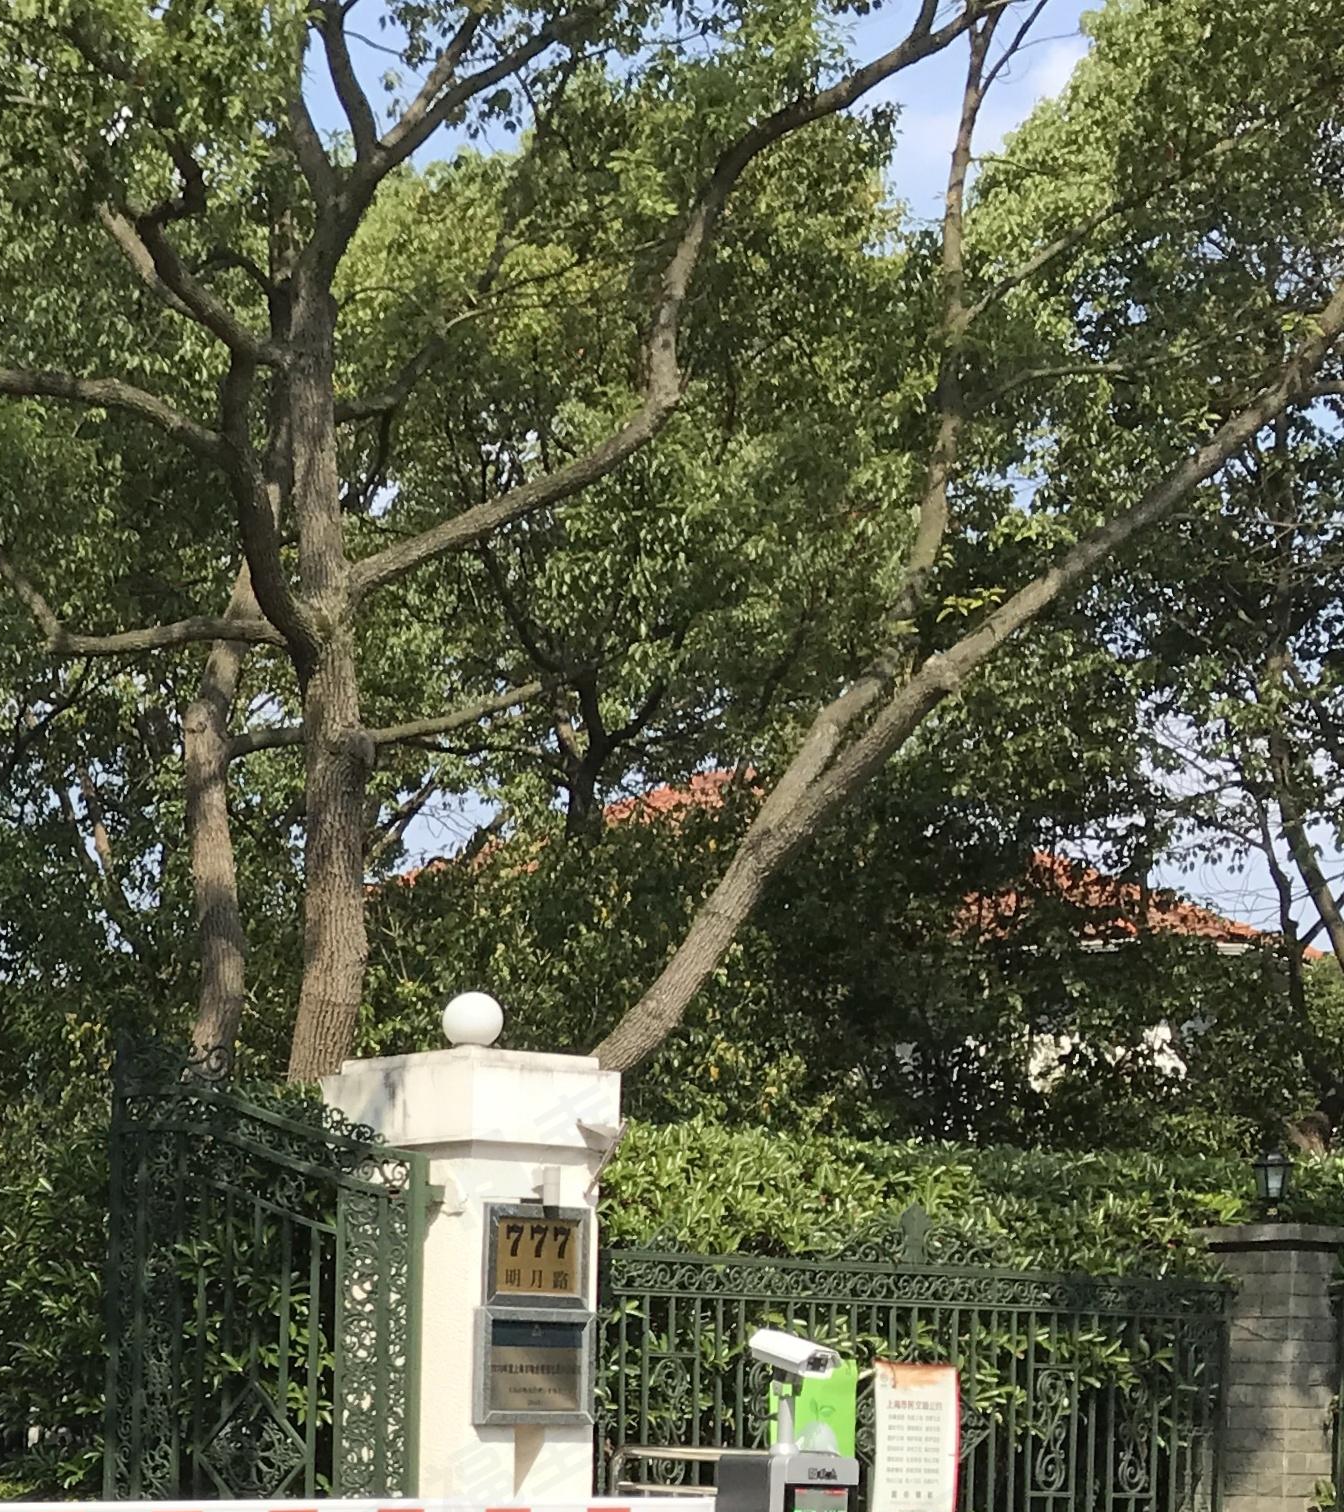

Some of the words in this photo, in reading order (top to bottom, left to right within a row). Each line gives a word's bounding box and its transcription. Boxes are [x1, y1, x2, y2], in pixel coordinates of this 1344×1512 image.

[506, 1223, 571, 1259] 777
[505, 1268, 569, 1290] 明月路
